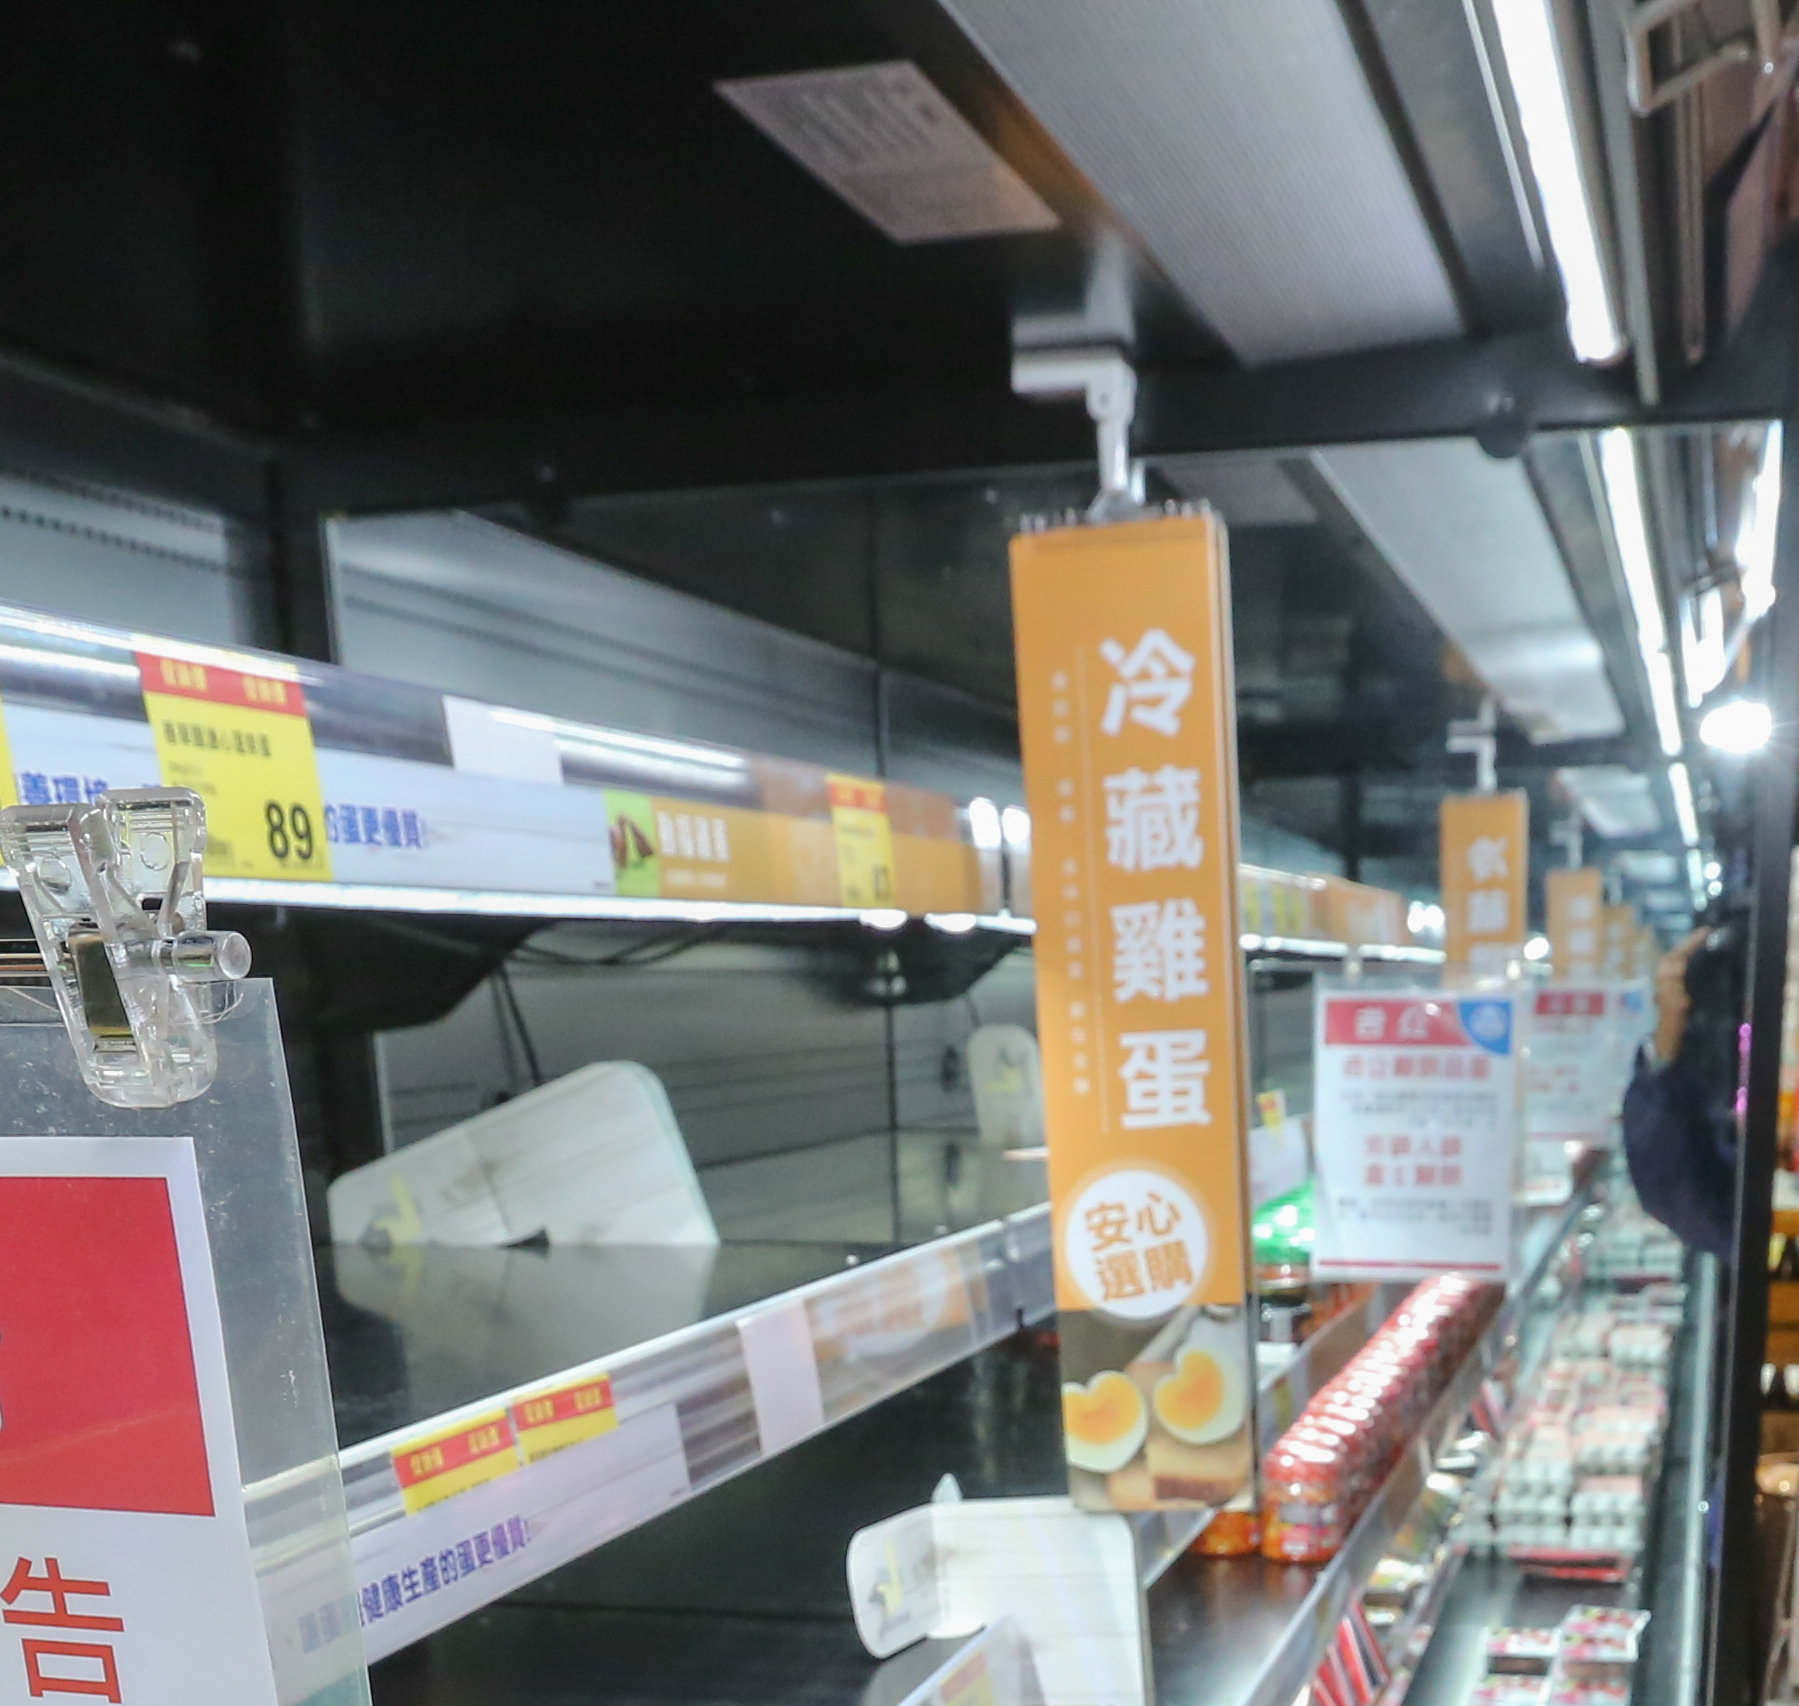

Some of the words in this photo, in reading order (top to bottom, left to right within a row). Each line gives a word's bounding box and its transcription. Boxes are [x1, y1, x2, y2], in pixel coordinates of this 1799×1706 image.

[264, 801, 313, 860] 89
[1098, 627, 1213, 1131] 冷藏雞蛋
[1083, 1190, 1182, 1252] 安心
